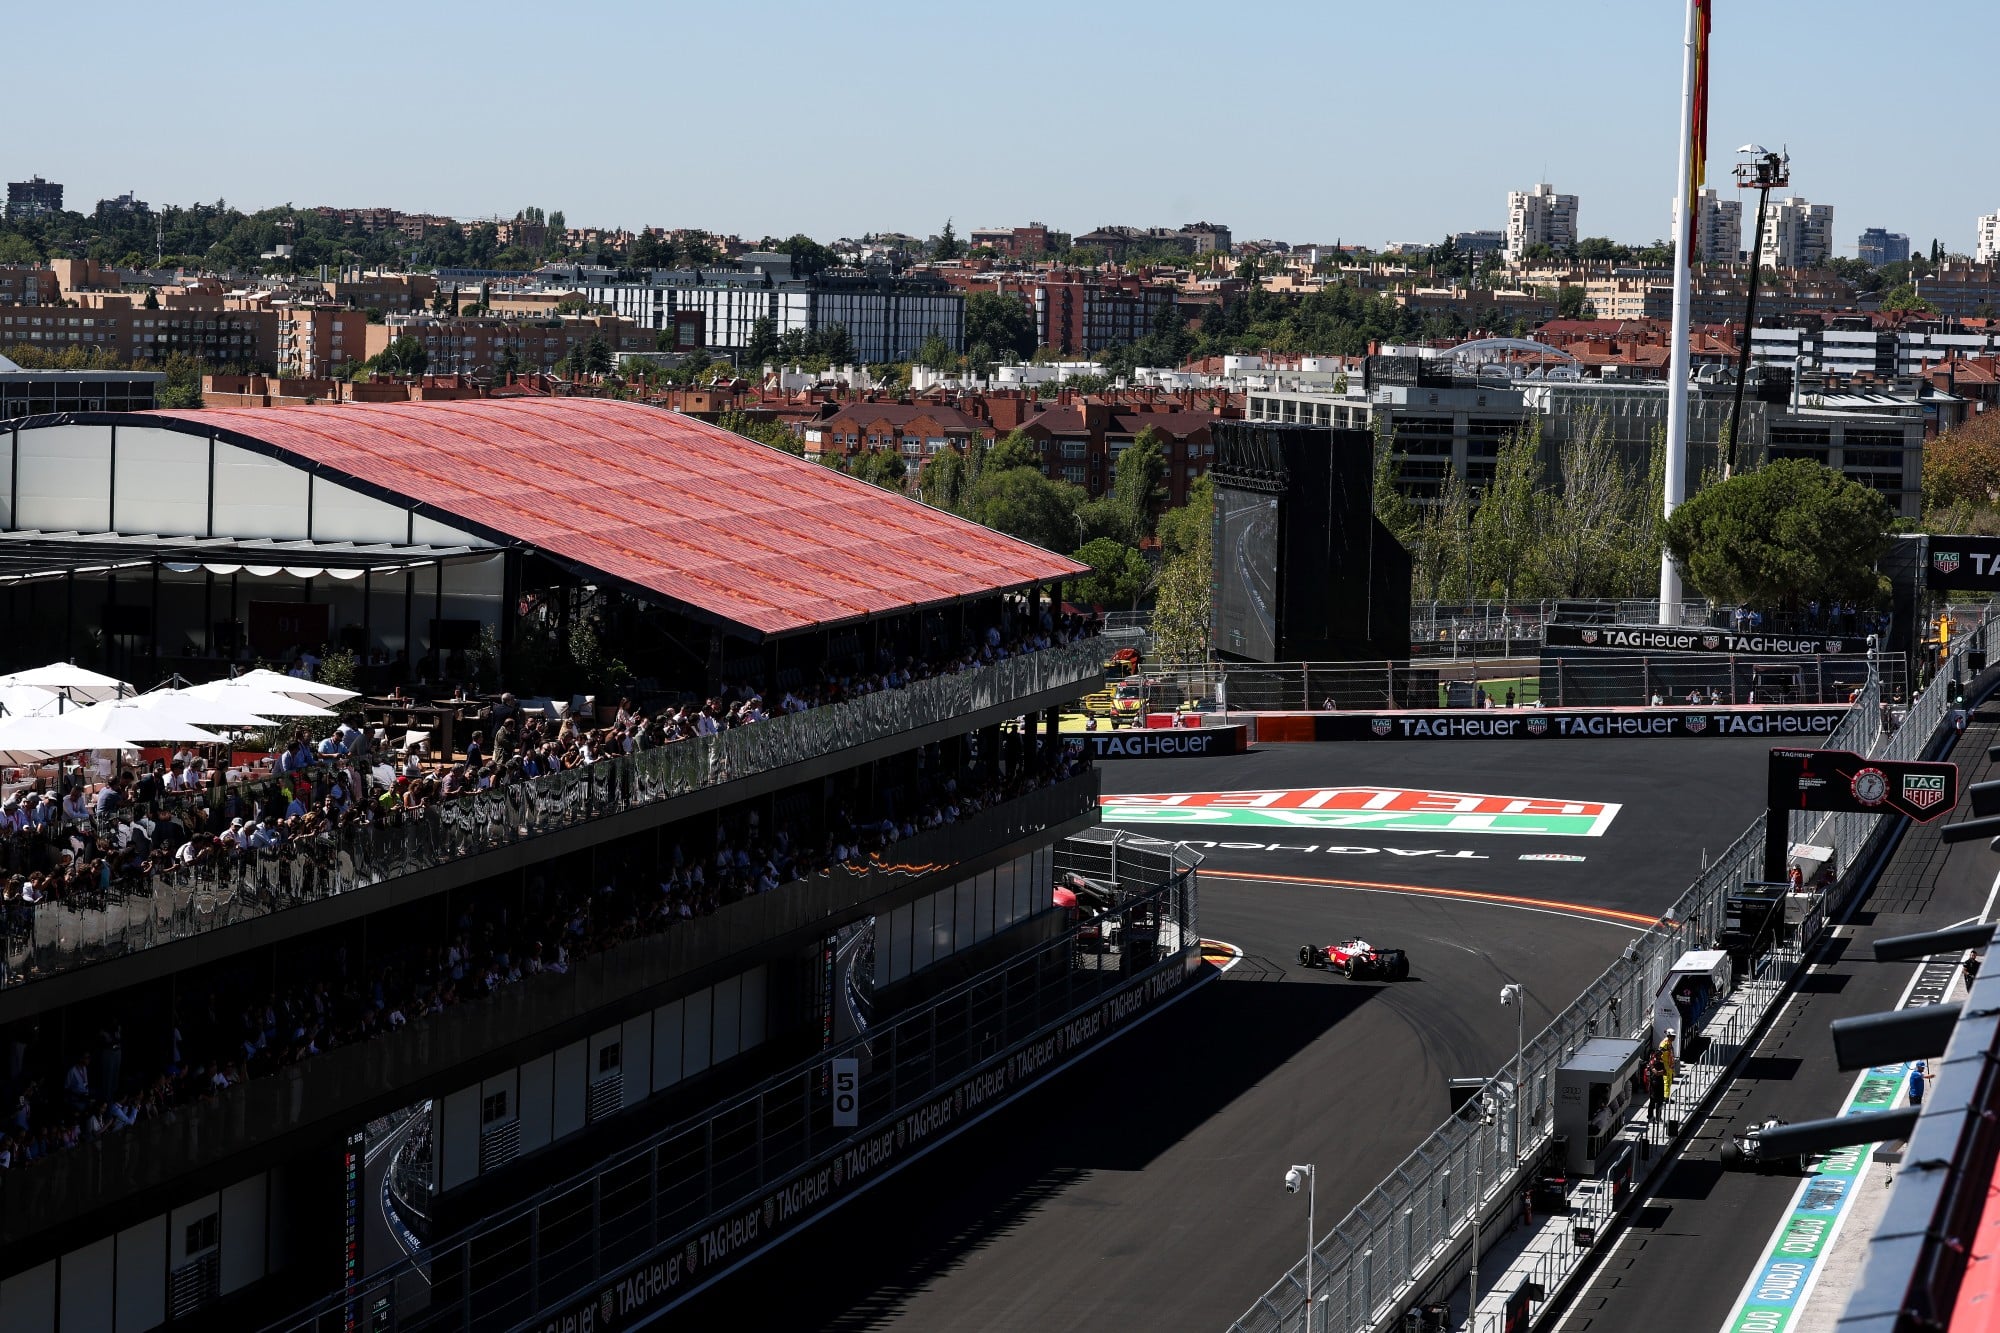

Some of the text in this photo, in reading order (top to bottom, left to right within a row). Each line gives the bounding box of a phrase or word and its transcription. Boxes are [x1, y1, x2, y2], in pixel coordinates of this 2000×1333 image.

[1936, 553, 1957, 561] TAG
[1603, 631, 1698, 649] TAGHeuer
[1724, 636, 1821, 654] TAGHeuer
[1399, 717, 1521, 737] TAGHeuer
[1554, 716, 1679, 736] TAGHeuer
[1713, 714, 1838, 734] TAGHeuer
[1092, 735, 1213, 756] TAGHeuer
[1905, 790, 1943, 807] HEUER
[1907, 777, 1941, 789] TAG
[1064, 1011, 1101, 1049] TAGHeuer
[1016, 1036, 1056, 1079] TAGHeuer
[837, 1072, 854, 1112] 50
[964, 1066, 1007, 1110] TAGHeuer
[906, 1096, 953, 1144] TAGHeuer
[844, 1129, 895, 1181] TAGHeuer
[776, 1167, 831, 1222] TAGHeuer
[699, 1208, 761, 1267] TAGHeuer
[616, 1252, 682, 1316] TAGHeuer
[1755, 1263, 1805, 1300] aramco
